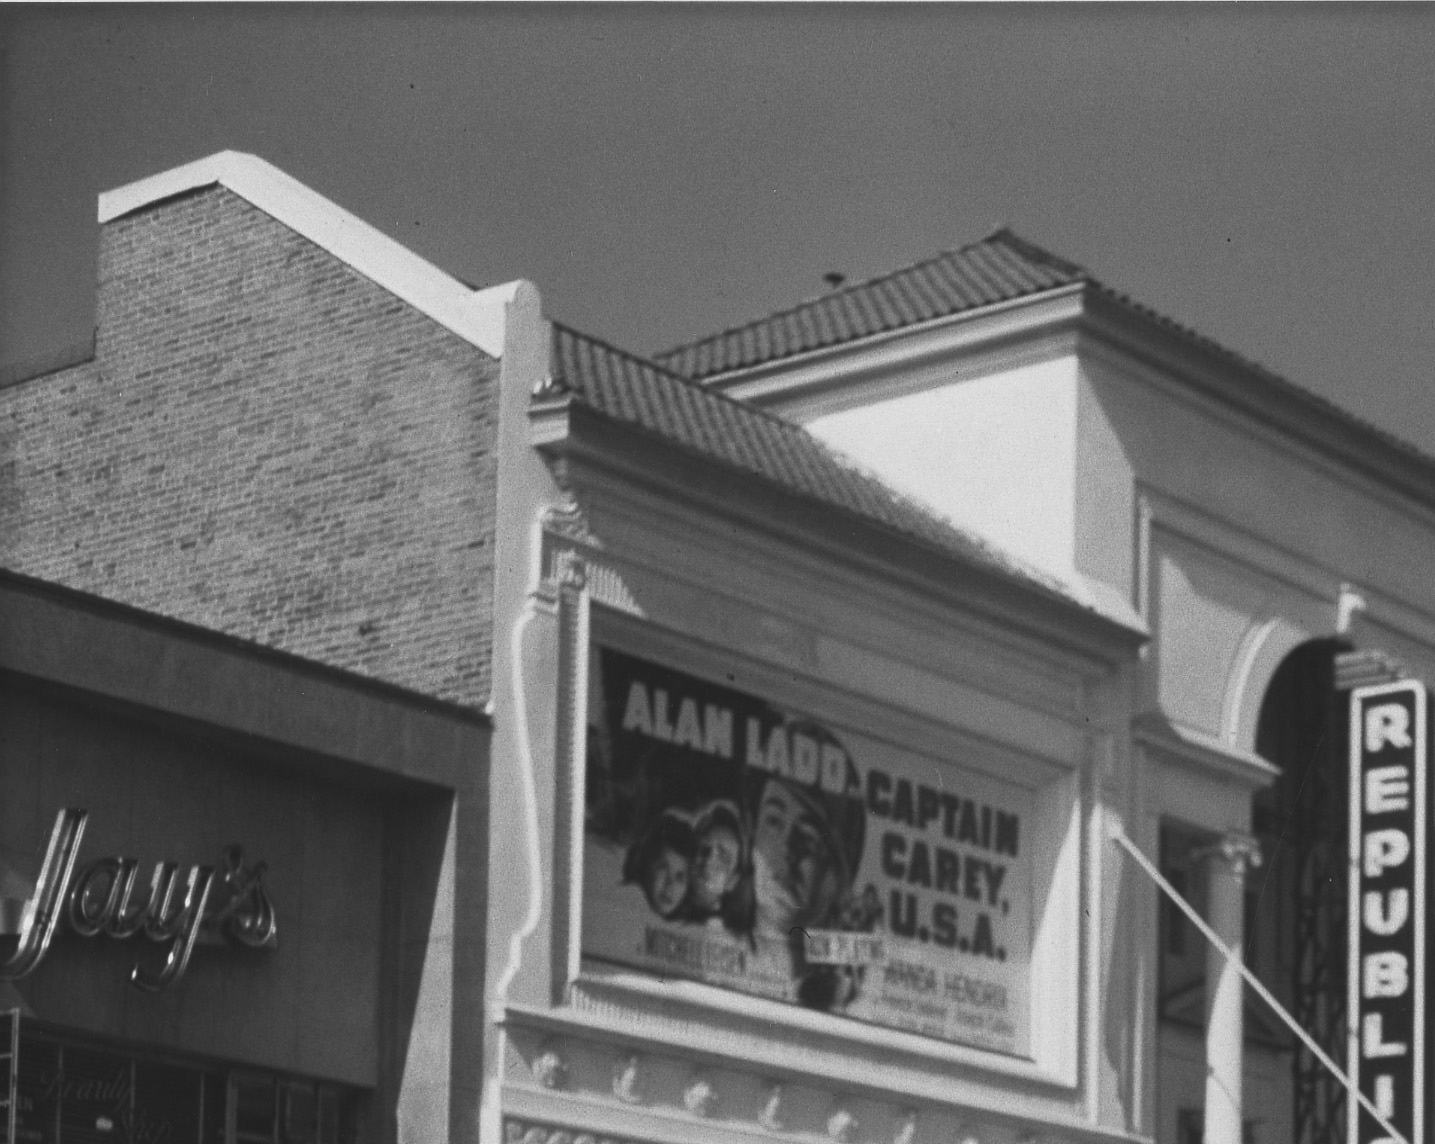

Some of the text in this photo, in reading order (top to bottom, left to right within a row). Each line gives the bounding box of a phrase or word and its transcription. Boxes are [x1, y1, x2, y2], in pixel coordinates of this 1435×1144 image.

[622, 682, 848, 795] ALAN LADD
[867, 769, 1020, 858] CAPTAIN
[0, 807, 279, 991] Jay's
[882, 832, 1011, 912] CAREY,
[891, 891, 1006, 962] U.S.A.
